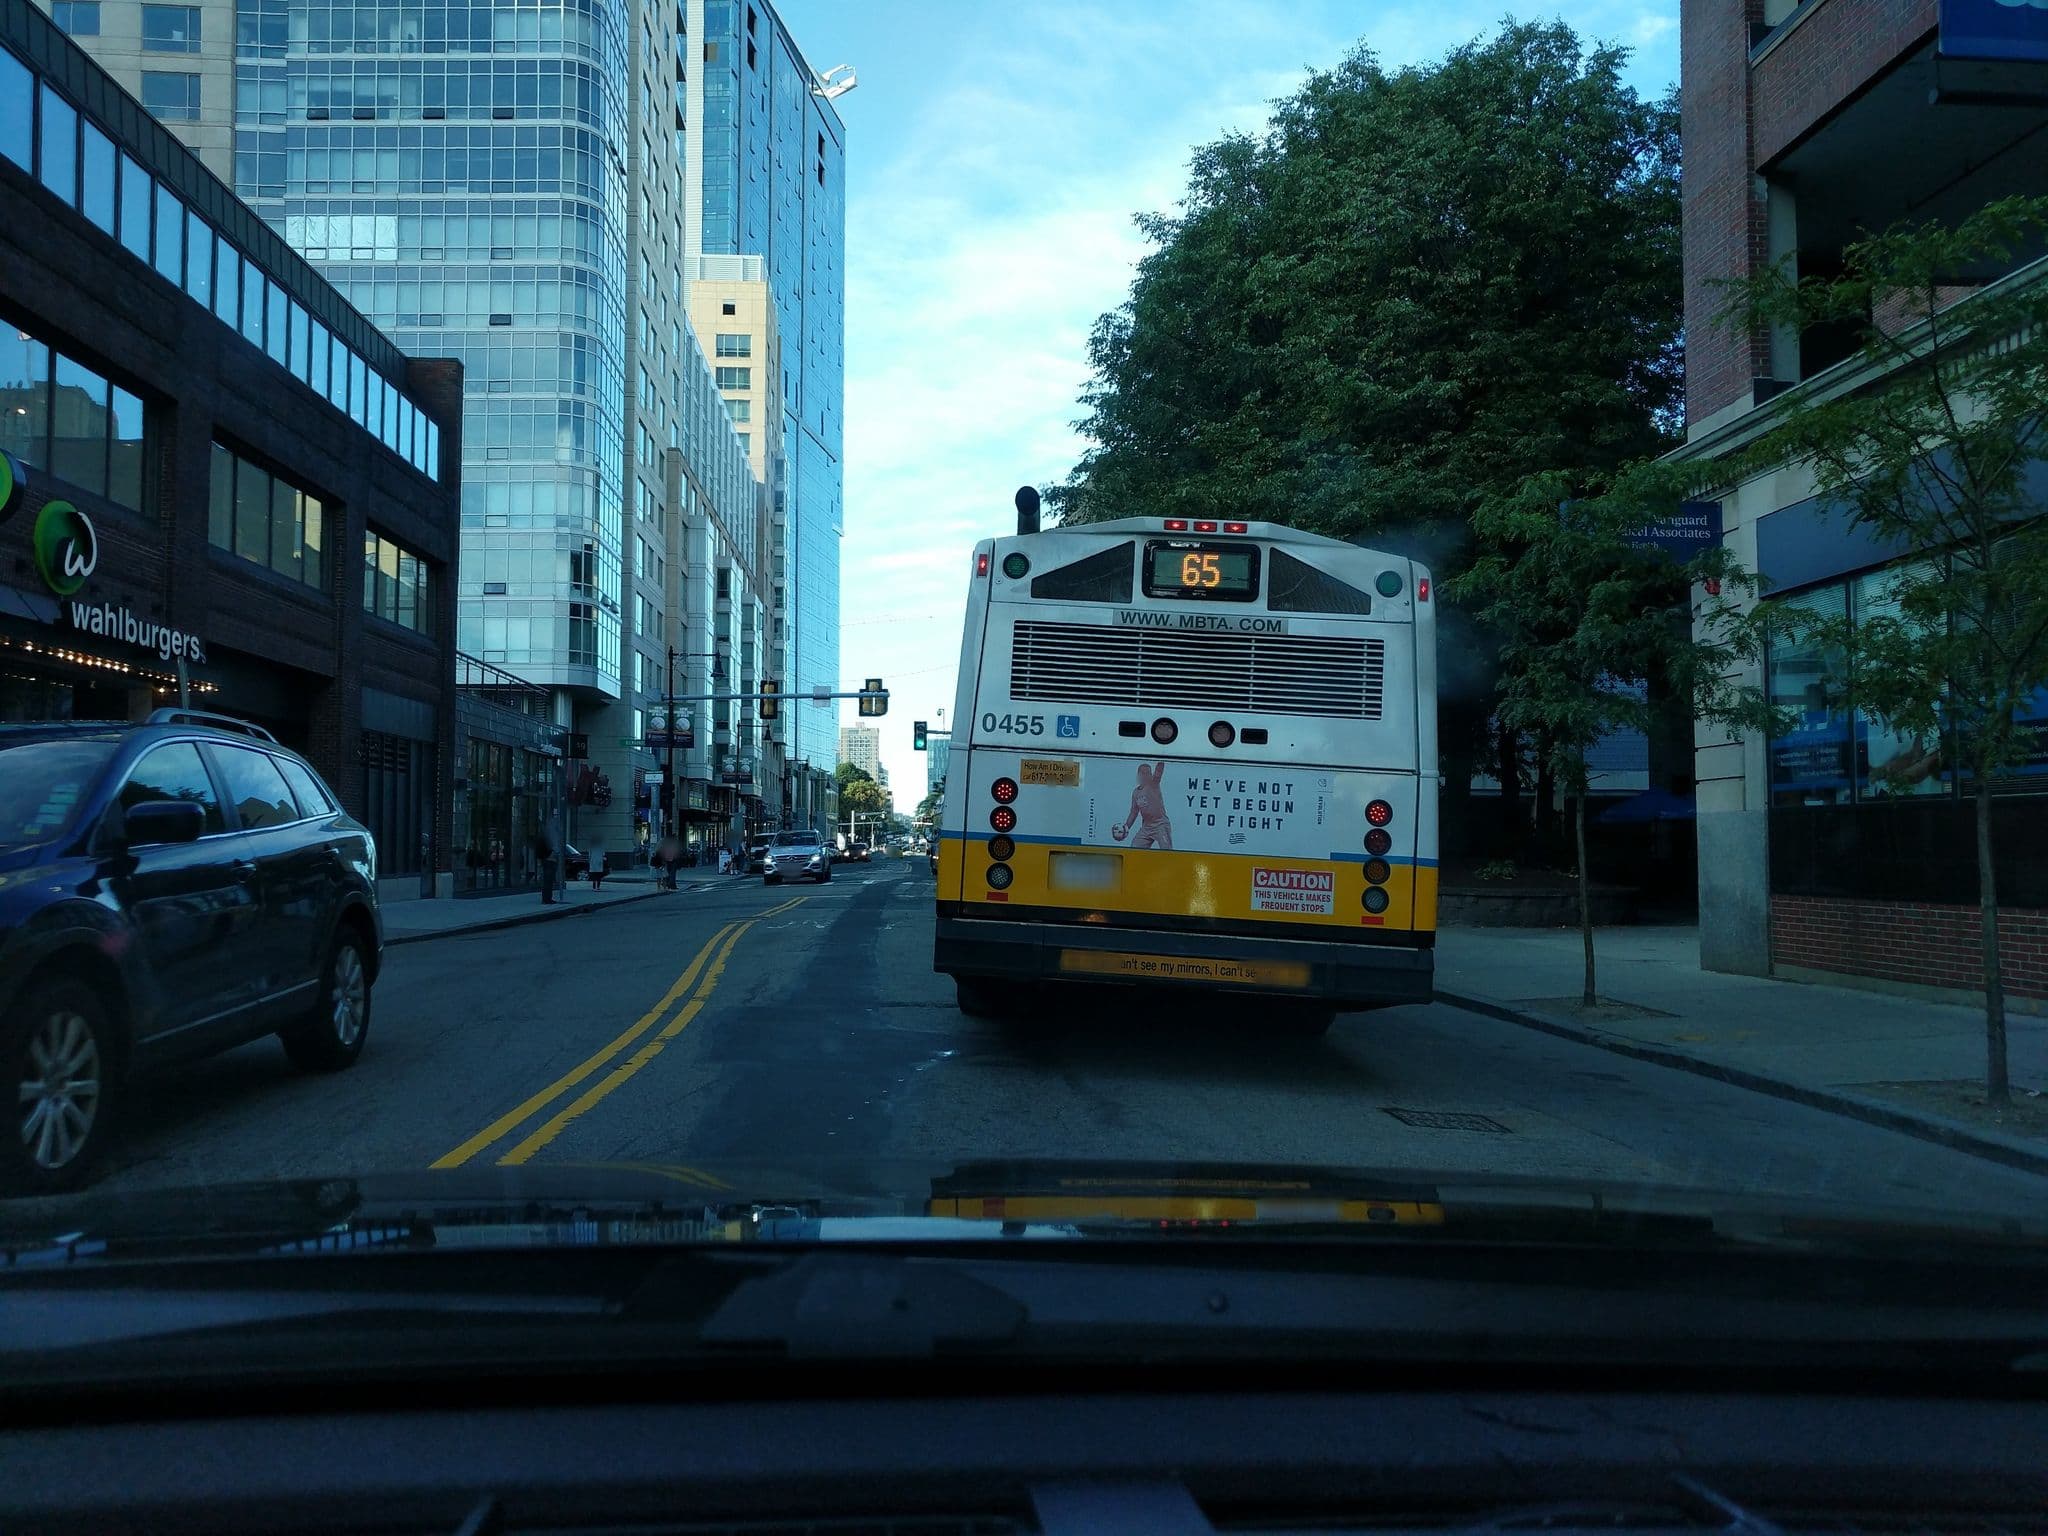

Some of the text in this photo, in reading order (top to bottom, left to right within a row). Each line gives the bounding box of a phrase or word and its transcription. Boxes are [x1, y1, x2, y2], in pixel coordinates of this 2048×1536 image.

[1650, 527, 1711, 539] Associates
[1182, 553, 1220, 587] 65
[71, 601, 200, 660] wahlburgers
[982, 712, 1045, 736] 0455
[1188, 778, 1294, 796] WE'VE NOT
[1187, 795, 1294, 813] YET BEGUN
[1195, 813, 1284, 831] TO FIGHT
[1256, 871, 1330, 889] CAUTION
[1254, 890, 1331, 902] THIS VEHICLE MAKES
[1261, 901, 1325, 913] FREQUENT STOPS
[1140, 960, 1157, 971] see
[1160, 962, 1175, 975] my
[1176, 962, 1213, 976] mirrors,
